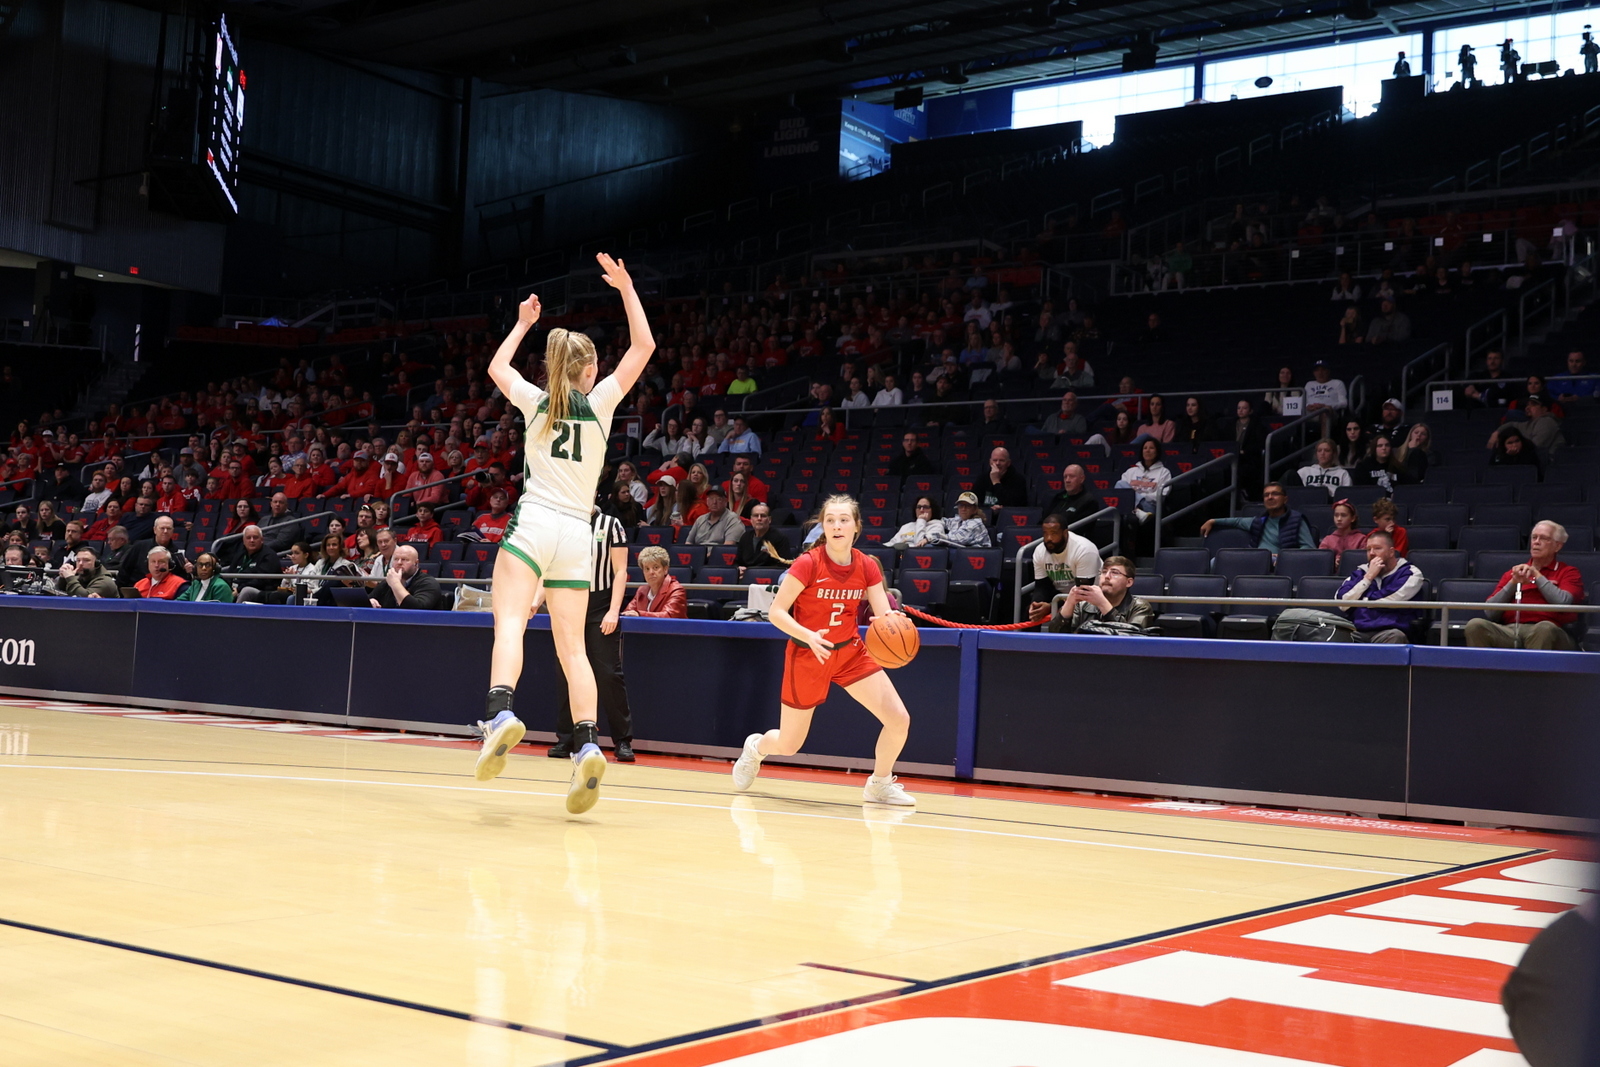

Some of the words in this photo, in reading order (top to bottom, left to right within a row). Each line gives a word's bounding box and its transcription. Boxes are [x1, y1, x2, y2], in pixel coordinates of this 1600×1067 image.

[779, 117, 806, 130] BUD
[773, 127, 810, 142] LIGHT
[763, 140, 820, 158] LANDING
[1286, 402, 1299, 410] 113
[1436, 396, 1449, 404] 114
[551, 421, 582, 462] 21
[1306, 475, 1340, 486] OHIO
[816, 588, 864, 600] BELLEVUE
[828, 602, 845, 627] 2
